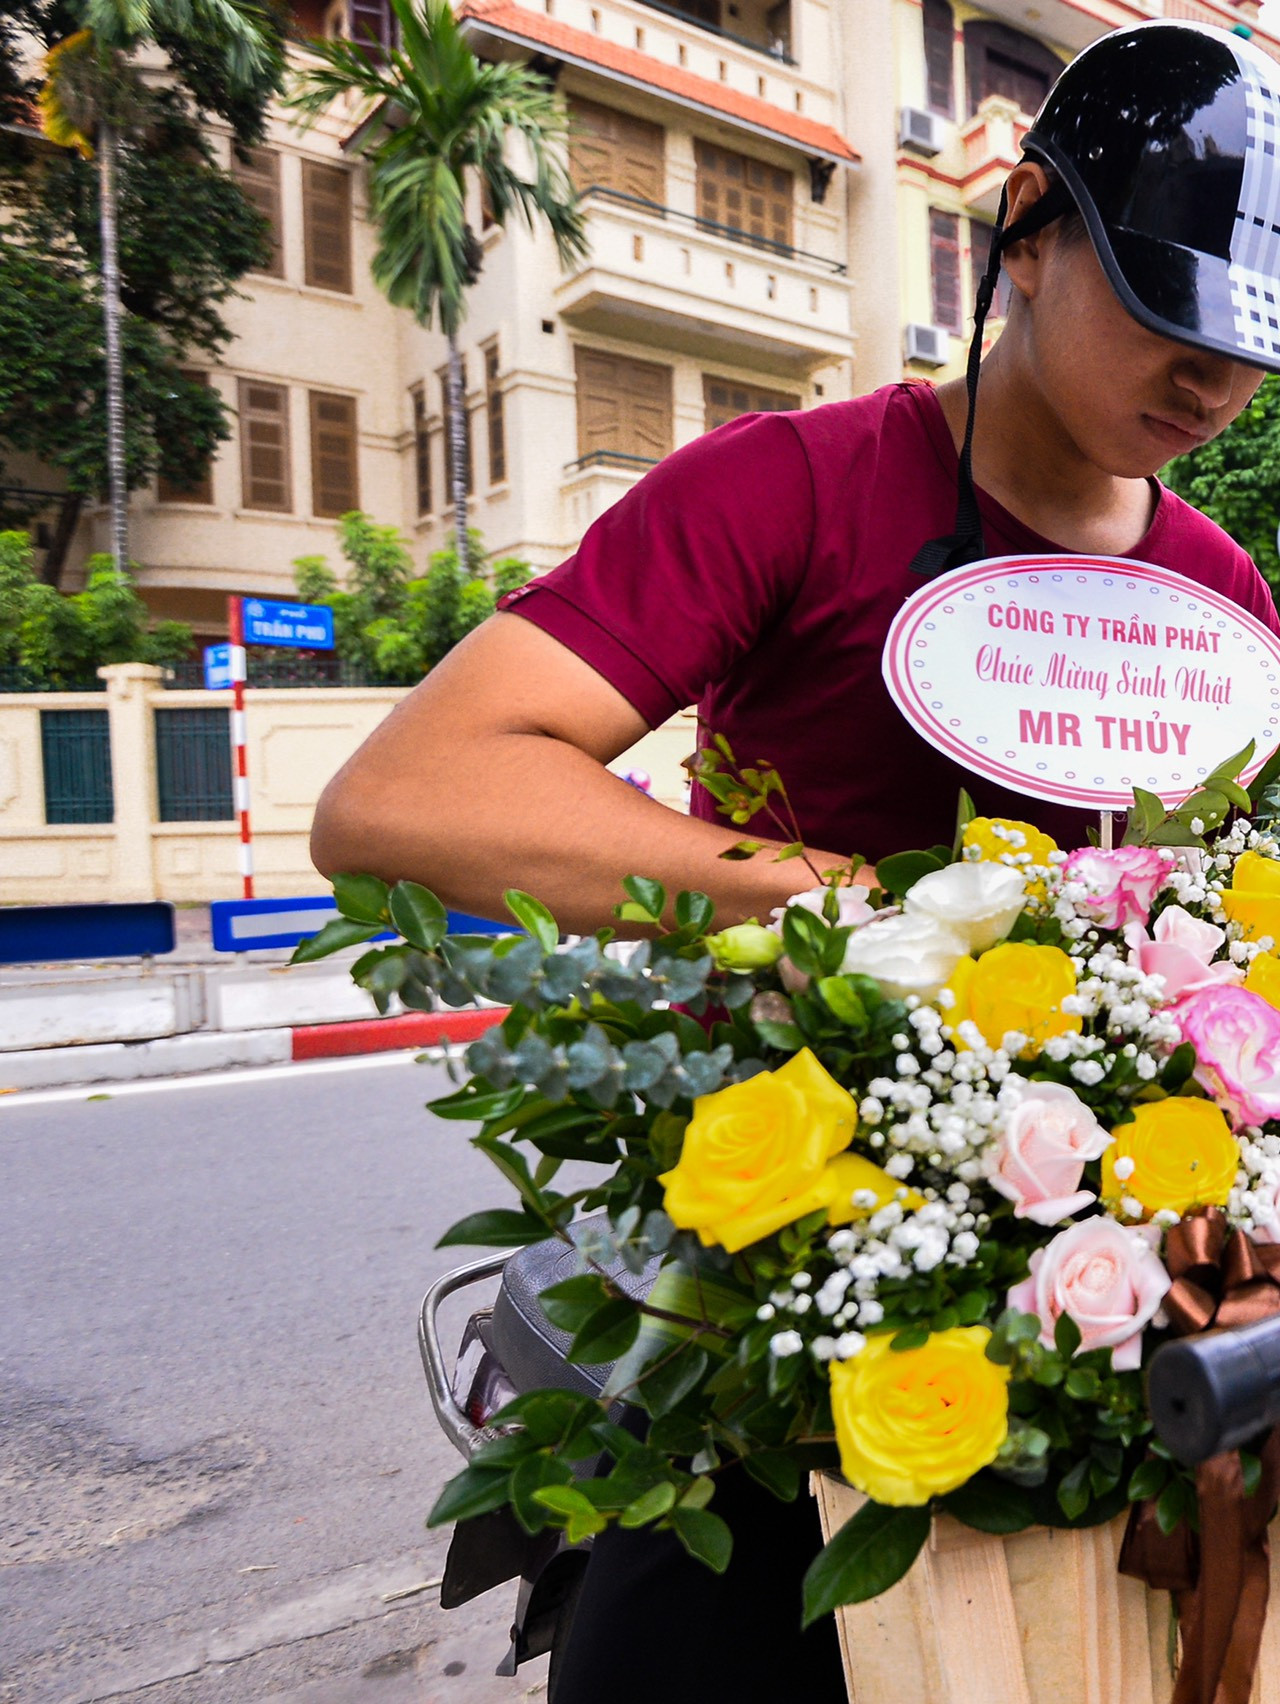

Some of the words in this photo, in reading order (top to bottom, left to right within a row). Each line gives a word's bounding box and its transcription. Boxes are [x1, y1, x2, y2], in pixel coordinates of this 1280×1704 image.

[987, 600, 1055, 635] CÔNG
[1062, 613, 1091, 639] TY
[1097, 613, 1157, 647] TRẦN
[1165, 625, 1221, 654] PHÁT
[975, 643, 1034, 686] Chúc
[1039, 652, 1111, 701] Mừng
[1116, 659, 1168, 699] Sinh
[1174, 666, 1232, 712] Nhật
[1018, 708, 1083, 748] MR
[1094, 710, 1192, 756] THỦY
